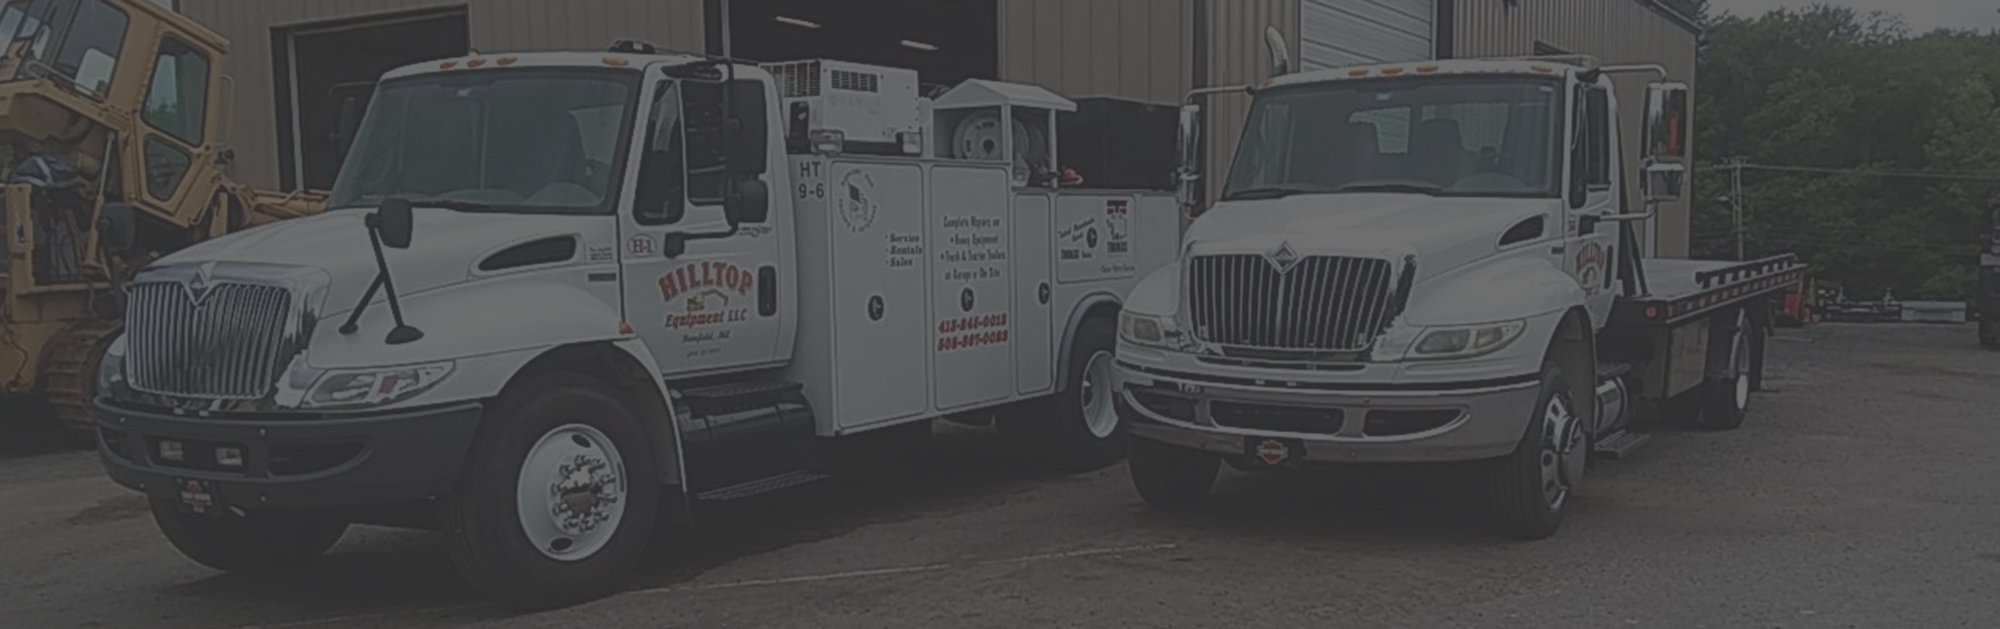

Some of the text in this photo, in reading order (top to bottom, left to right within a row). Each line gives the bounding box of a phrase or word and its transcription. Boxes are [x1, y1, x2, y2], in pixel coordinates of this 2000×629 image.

[799, 161, 821, 178] HT
[798, 182, 825, 199] 9-6
[889, 232, 920, 243] Service
[889, 245, 922, 255] Rentals
[889, 256, 913, 267] Sales
[658, 261, 753, 302] HILLTOP
[664, 308, 748, 330] Equipment LLC
